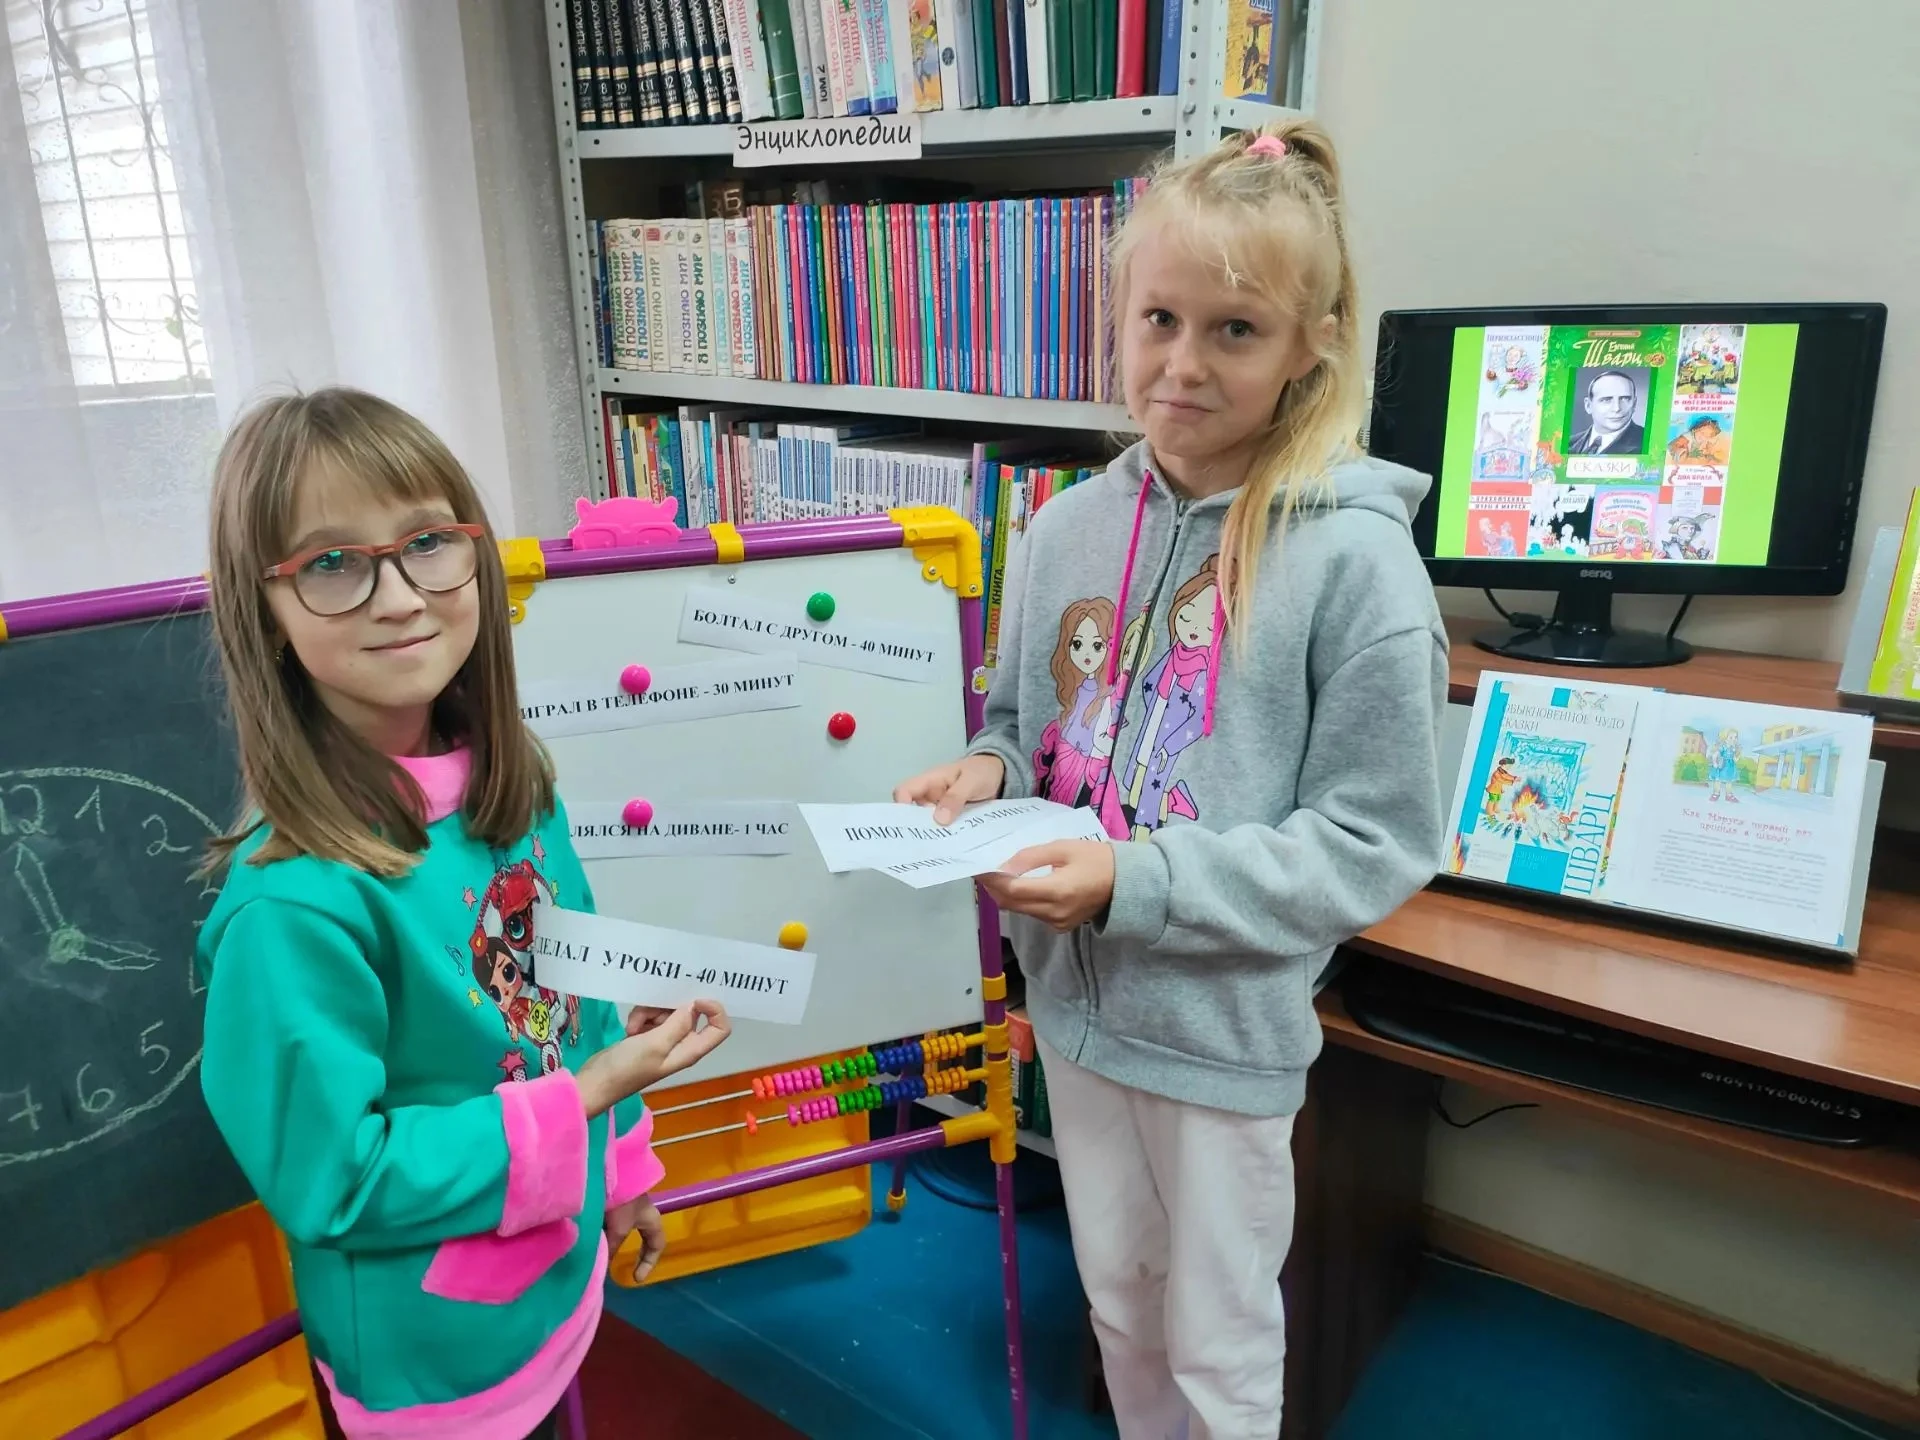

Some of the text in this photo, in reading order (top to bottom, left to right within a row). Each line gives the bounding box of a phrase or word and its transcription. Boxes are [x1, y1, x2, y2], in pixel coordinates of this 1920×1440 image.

[738, 117, 913, 155] Энциклопедии
[694, 609, 762, 633] БОЛТАЛ
[766, 622, 779, 636] С
[780, 625, 848, 649] ДРУГОМ
[859, 639, 876, 653] 40
[878, 643, 936, 664] МИНУТ
[587, 699, 599, 712] В
[601, 686, 701, 710] ТЕЛЕФОНЕ
[712, 682, 730, 696] 30
[733, 674, 796, 694] МИНУТ
[74, 784, 105, 833] 1
[570, 824, 632, 838] ЛЯЛСЯ
[637, 823, 660, 836] НА
[756, 823, 789, 835] ЧАС
[844, 827, 904, 843] ПОМОГ
[970, 817, 985, 828] 20
[142, 814, 192, 857] 2
[534, 935, 591, 963] ДЕЛАЛ
[602, 950, 682, 980] УРОКИ
[696, 967, 717, 984] 40
[719, 971, 789, 995] МИНУТ
[140, 1020, 171, 1075] 5
[76, 1062, 116, 1113] 6
